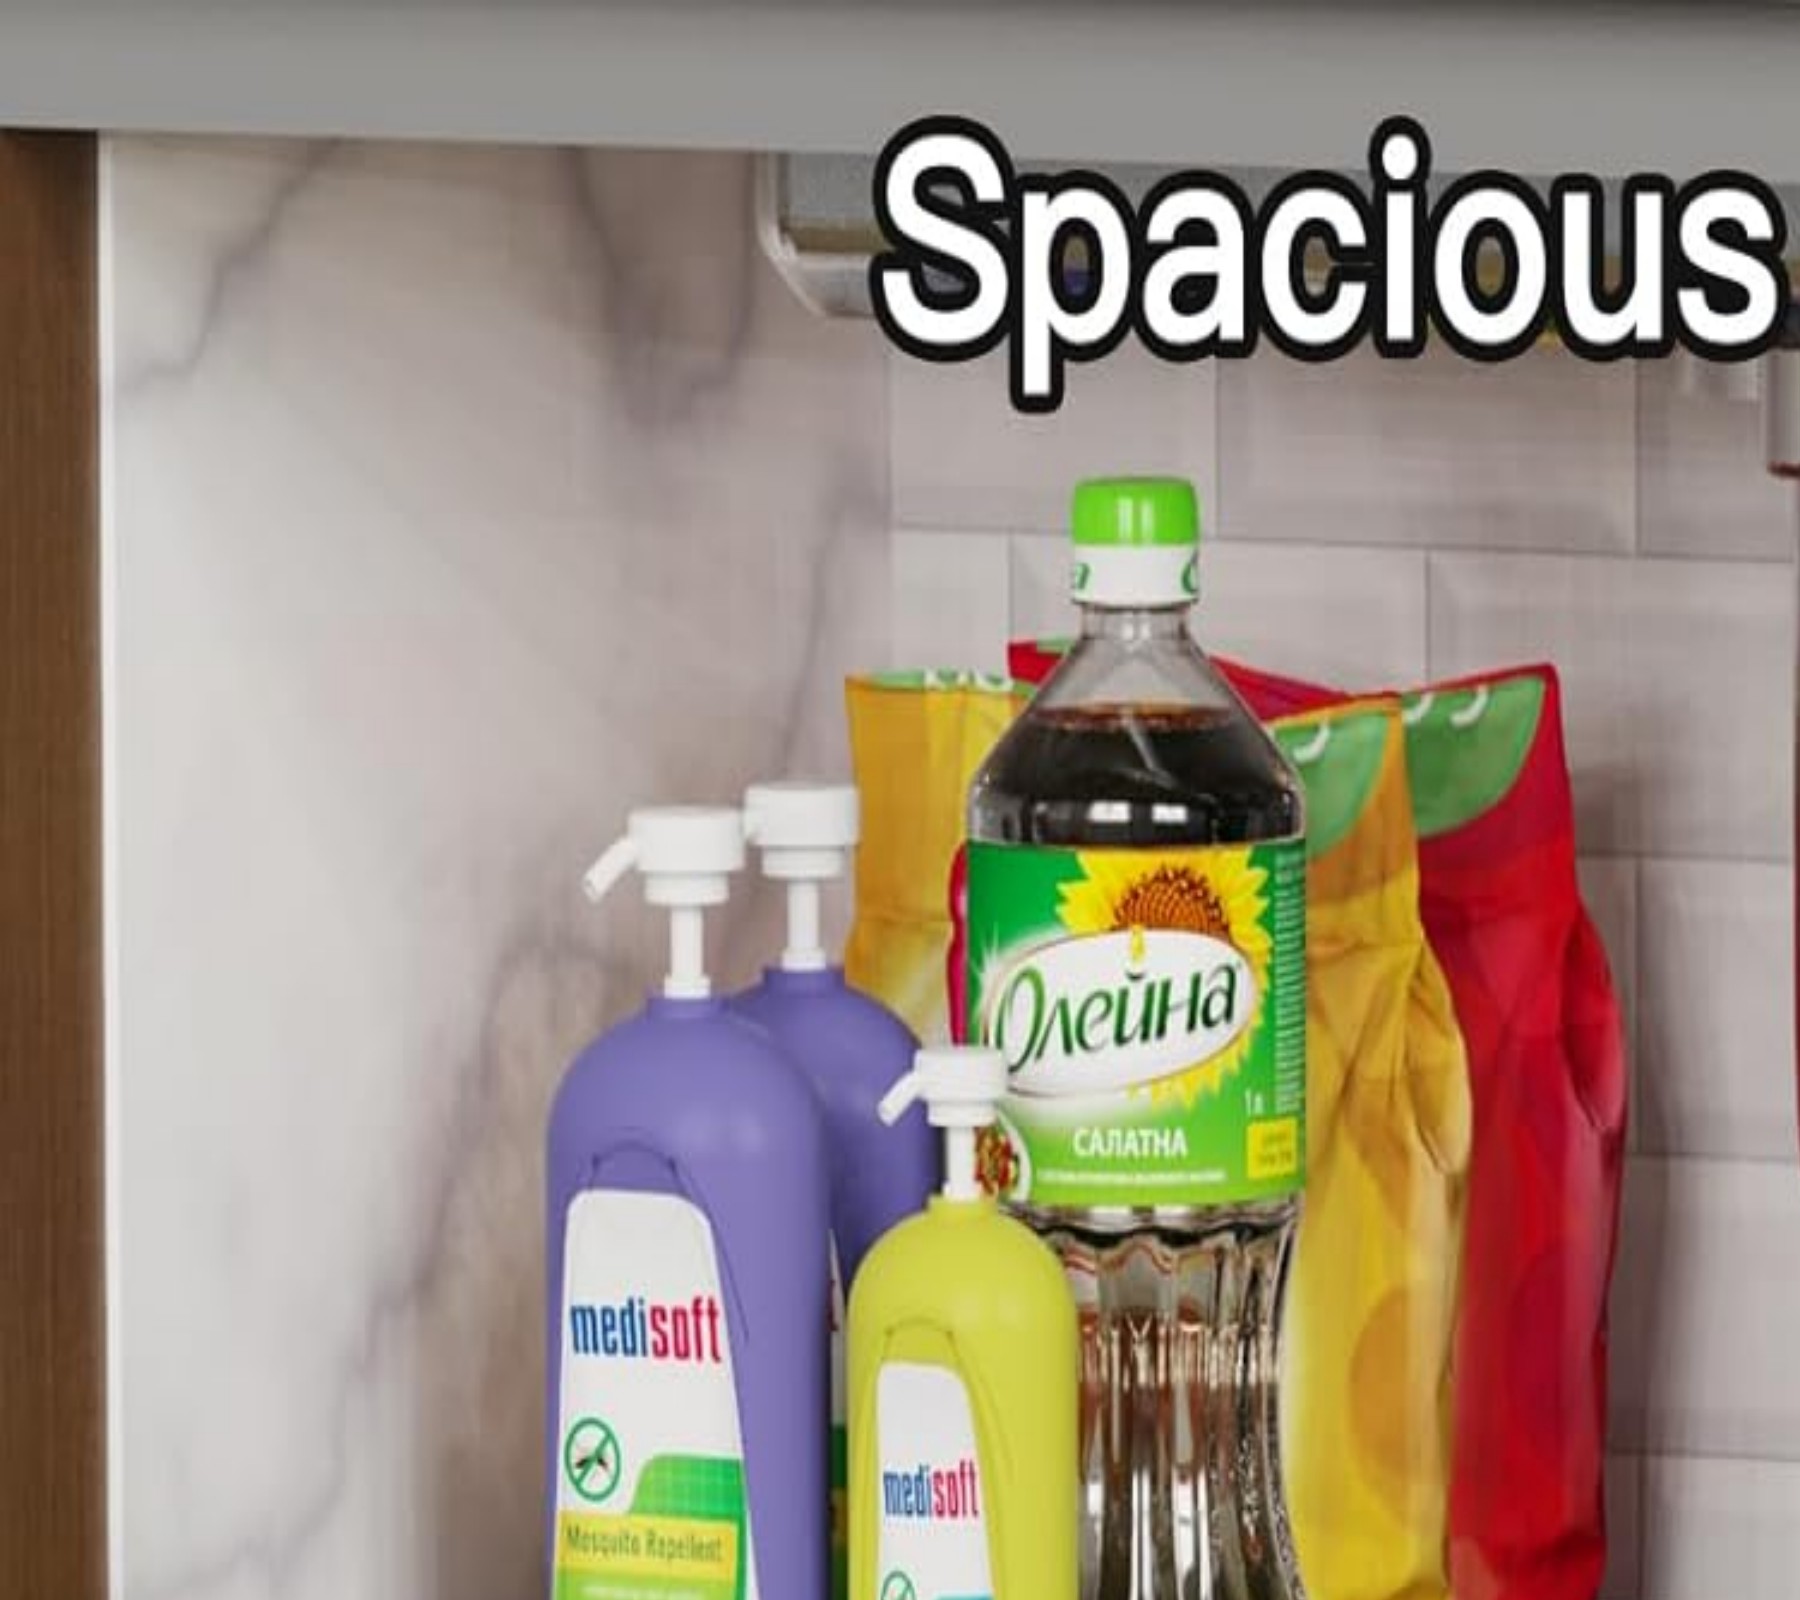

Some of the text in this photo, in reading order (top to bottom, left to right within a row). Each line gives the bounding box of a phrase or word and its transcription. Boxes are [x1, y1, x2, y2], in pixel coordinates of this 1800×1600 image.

[995, 962, 1237, 1075] Олейна
[1072, 1126, 1189, 1158] САЛАТНА
[570, 1295, 722, 1363] medisoft
[883, 1459, 980, 1519] medisoft
[567, 1526, 724, 1562] Mosquito Repellent
